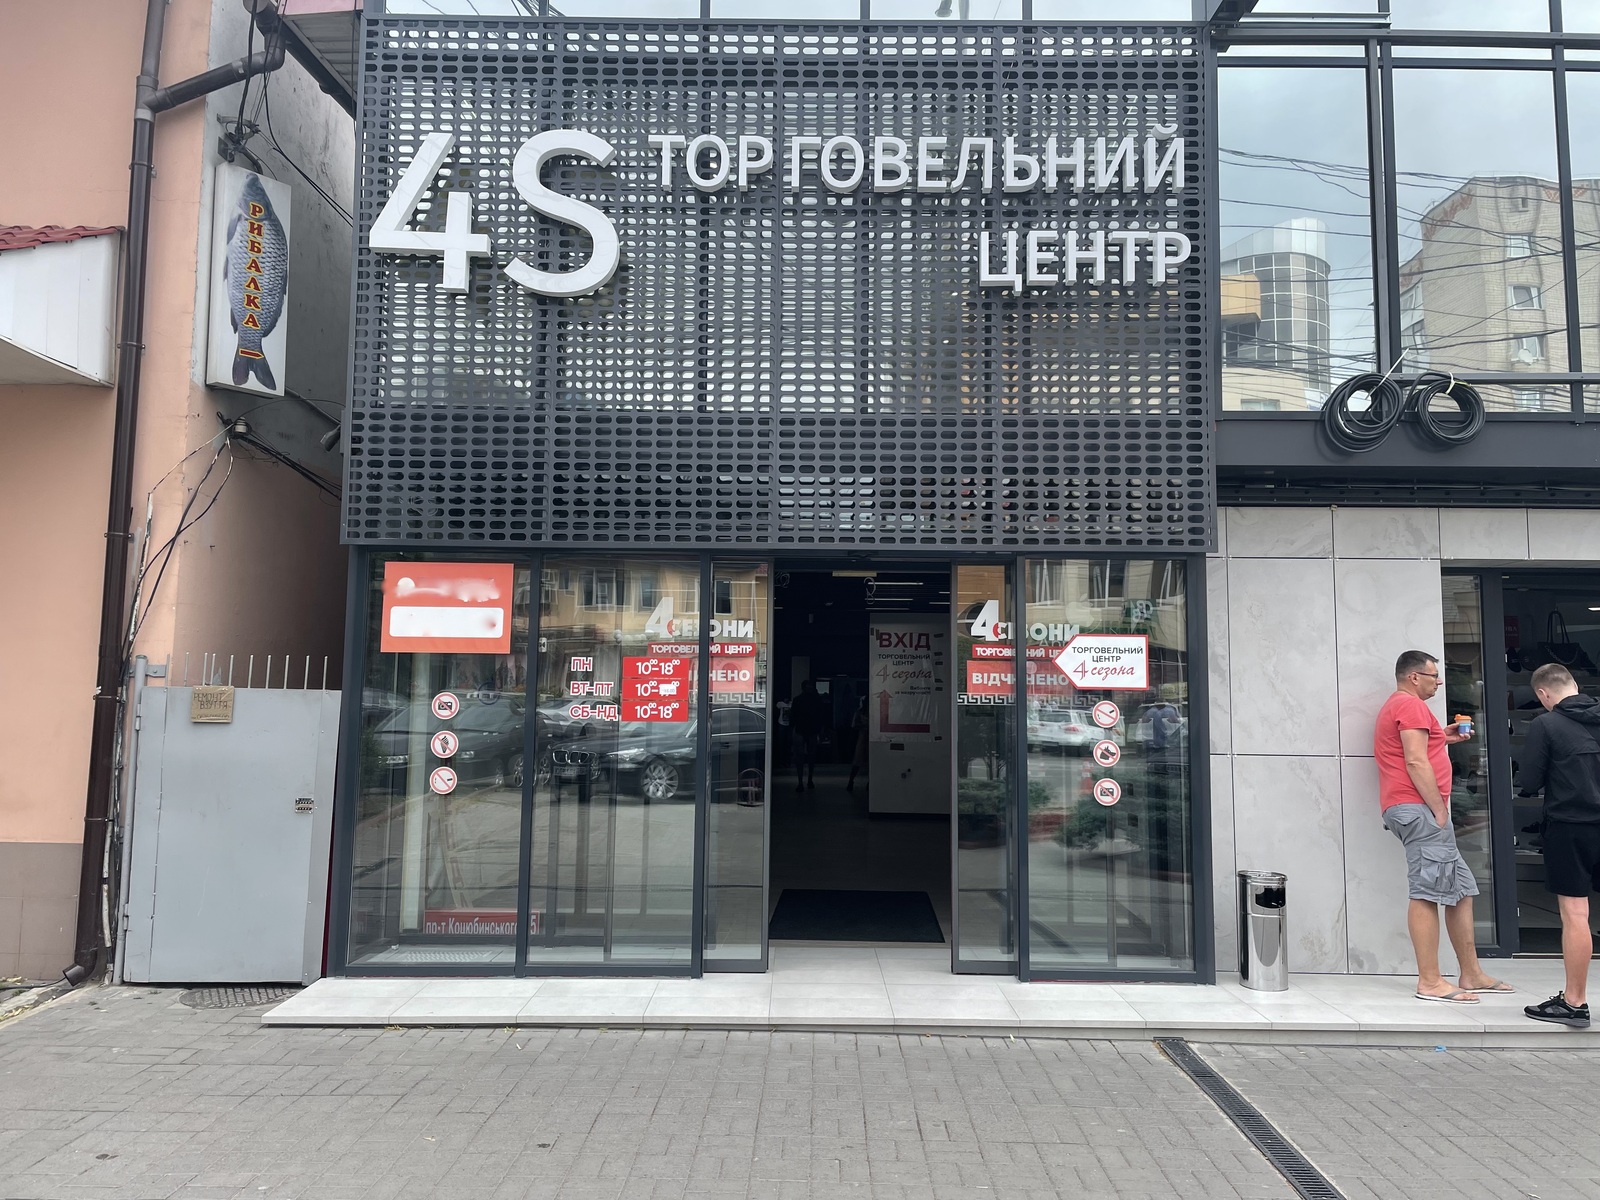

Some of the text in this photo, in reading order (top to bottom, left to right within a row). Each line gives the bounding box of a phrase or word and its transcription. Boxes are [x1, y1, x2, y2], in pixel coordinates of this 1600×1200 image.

[648, 123, 1185, 195] ТОРГОВЕЛЬНИЙ
[368, 129, 620, 298] 4S
[243, 202, 264, 330] РИБАЛКА
[979, 231, 1192, 296] ЦЕНТР
[645, 597, 674, 638] 4
[971, 600, 999, 641] 4
[651, 644, 753, 655] ТОРГОВЕЛИЙ ЦЕНТР
[879, 632, 931, 651] ВХІД
[1072, 646, 1144, 655] ТОРГОВЕЛЬНИЙ
[975, 647, 1046, 658] ТОРГОВНИЙ
[1092, 655, 1122, 664] ЦЕНТР
[571, 657, 593, 671] ПН
[1073, 660, 1136, 681] 4 сезона
[876, 664, 933, 684] 4 сезона
[570, 681, 614, 696] ВТ-ПТ
[569, 705, 618, 721] СБ-НД
